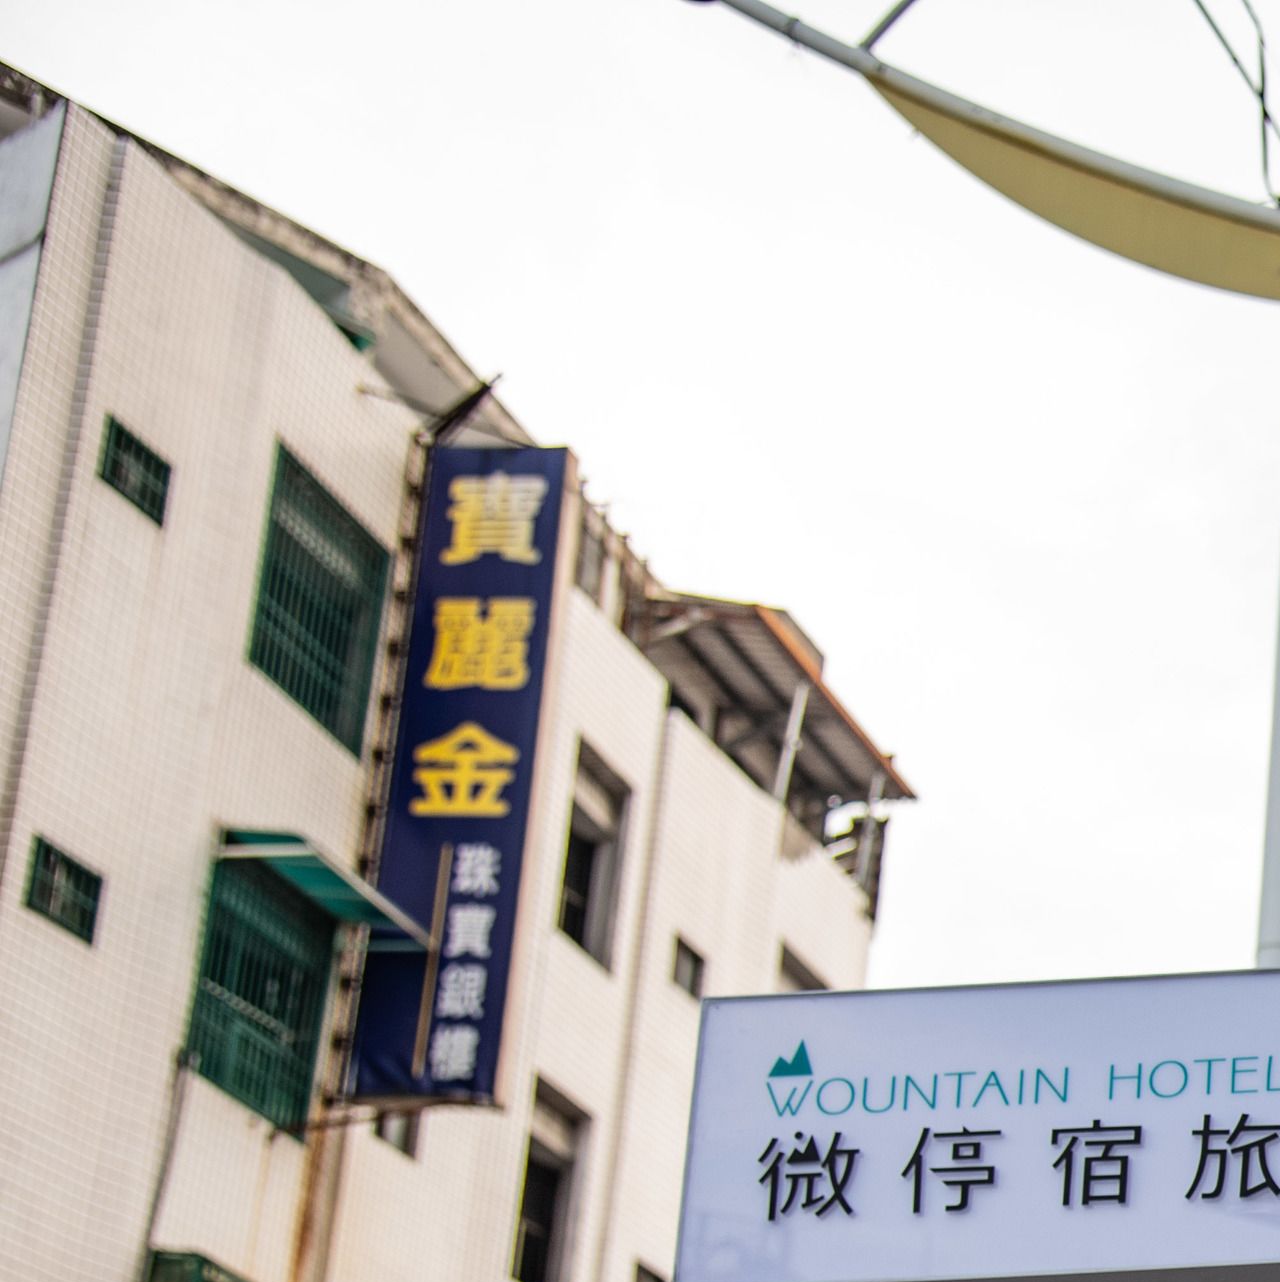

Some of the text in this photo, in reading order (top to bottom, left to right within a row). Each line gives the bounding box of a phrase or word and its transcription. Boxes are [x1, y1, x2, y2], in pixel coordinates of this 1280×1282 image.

[408, 470, 549, 819] 寶麗金
[428, 842, 501, 1082] 珠寶銀樓
